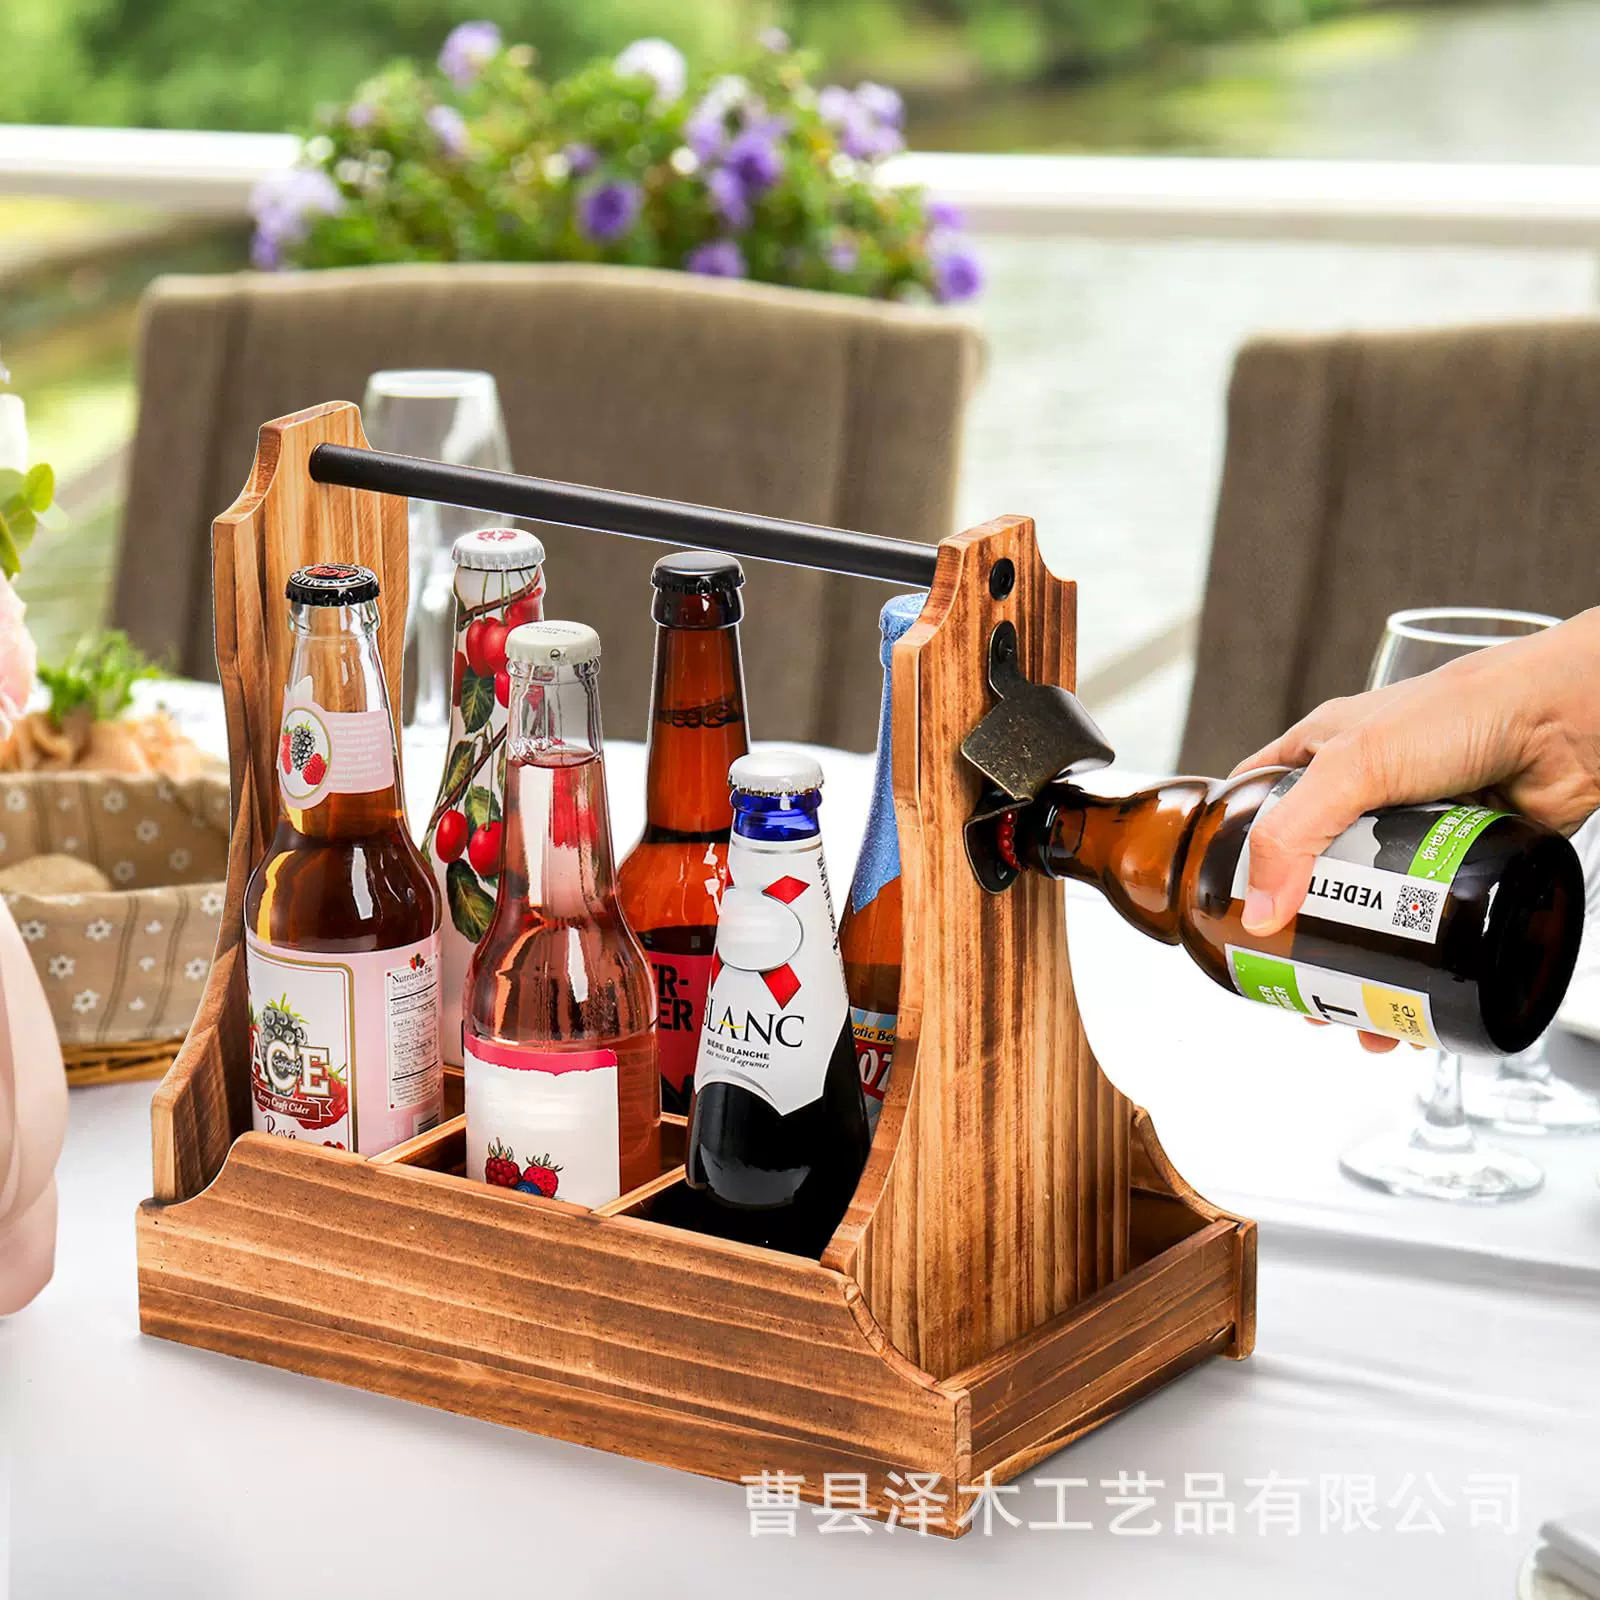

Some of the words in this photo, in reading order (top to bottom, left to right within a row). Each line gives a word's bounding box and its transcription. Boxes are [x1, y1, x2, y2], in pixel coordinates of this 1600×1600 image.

[726, 1045, 770, 1060] BLANCHE
[251, 1030, 330, 1097] ACE
[288, 1101, 310, 1115] Cider
